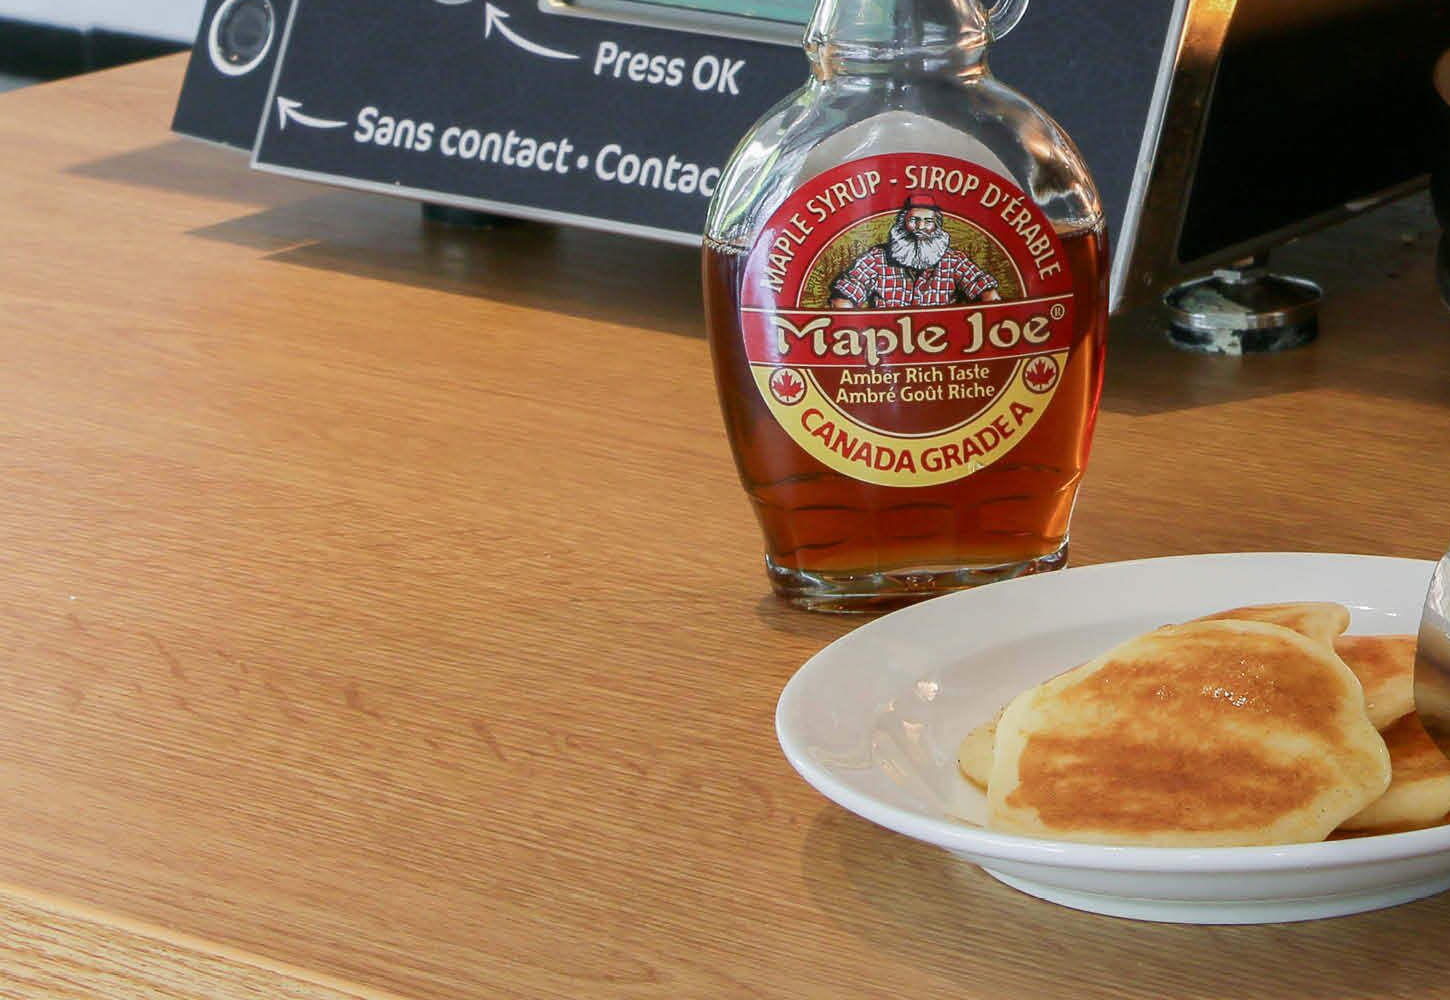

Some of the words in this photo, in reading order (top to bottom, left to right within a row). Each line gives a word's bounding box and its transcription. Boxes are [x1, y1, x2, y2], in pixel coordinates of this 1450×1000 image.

[593, 40, 686, 87] Press
[692, 55, 746, 96] OK
[353, 106, 435, 152] Sans
[439, 126, 574, 174] contact
[595, 143, 720, 198] Contac
[761, 213, 815, 294] MAPLE
[806, 170, 881, 223] SYRUP
[904, 165, 980, 197] SIROP
[979, 184, 1062, 281] D'ÉRABLE
[770, 316, 948, 367] Maple
[836, 386, 897, 404] Ambré
[900, 385, 943, 402] Goût
[948, 384, 996, 400] Riche
[840, 369, 900, 385] Amber
[906, 366, 944, 382] Rich
[949, 365, 990, 380] Taste
[801, 408, 917, 474] CANADA
[920, 414, 1018, 473] GRADE
[1009, 400, 1034, 427] A
